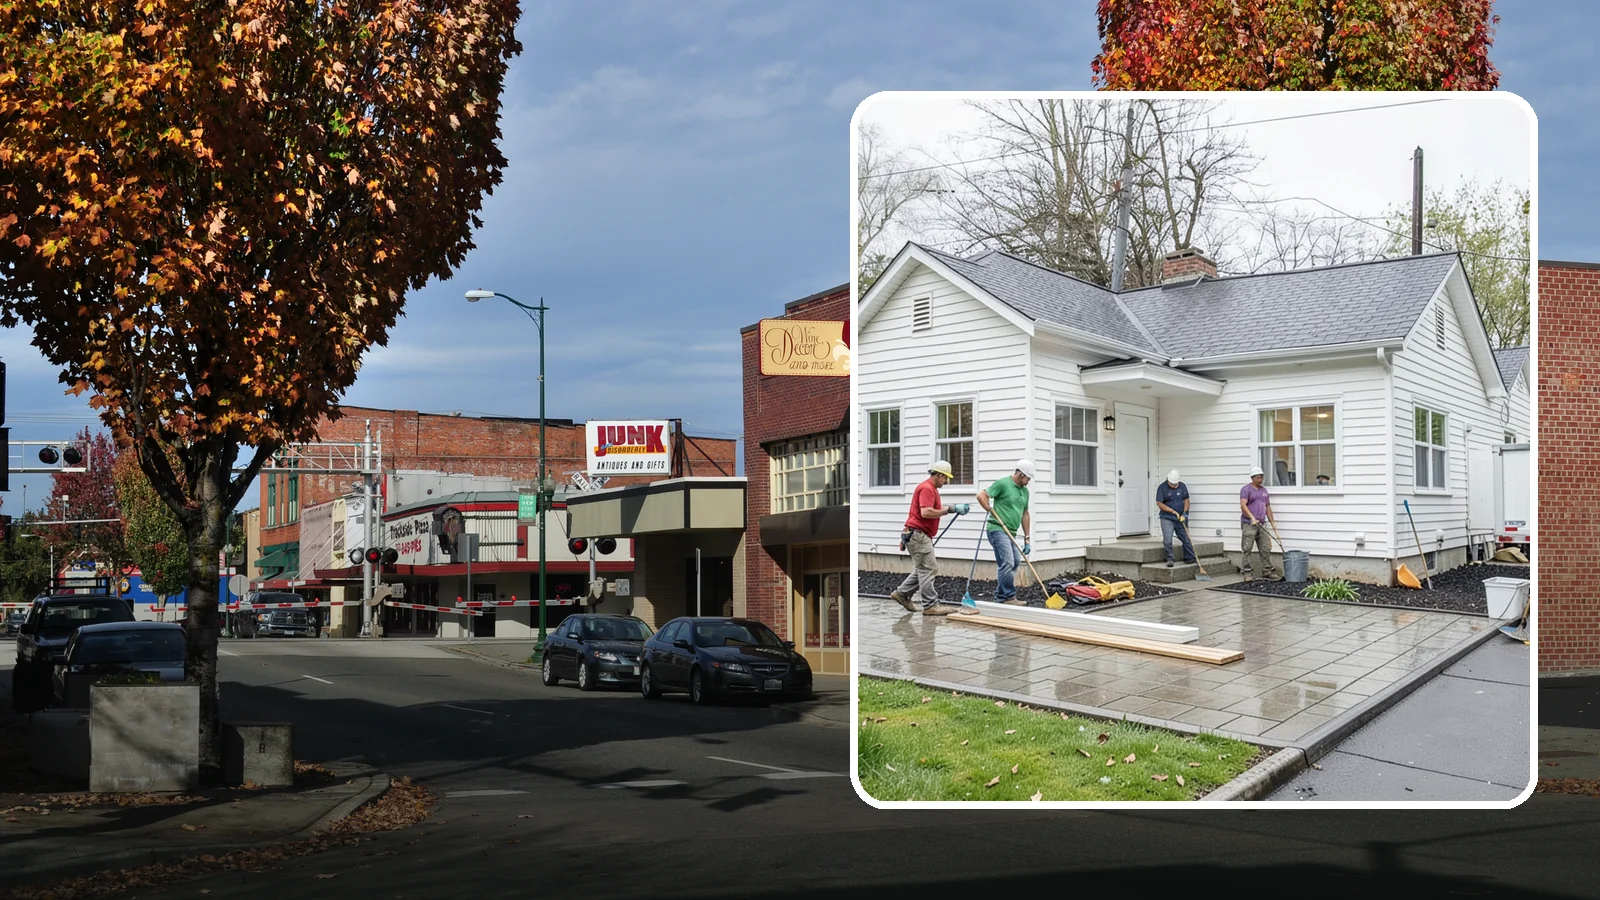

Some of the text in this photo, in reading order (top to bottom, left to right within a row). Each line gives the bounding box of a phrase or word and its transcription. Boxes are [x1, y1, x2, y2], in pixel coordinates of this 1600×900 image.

[791, 325, 823, 345] Wine
[595, 425, 666, 457] JUNK
[607, 446, 646, 454] DISORDERLY
[597, 460, 665, 470] ANTIQUES AND GIFTS
[414, 519, 429, 535] Pizza
